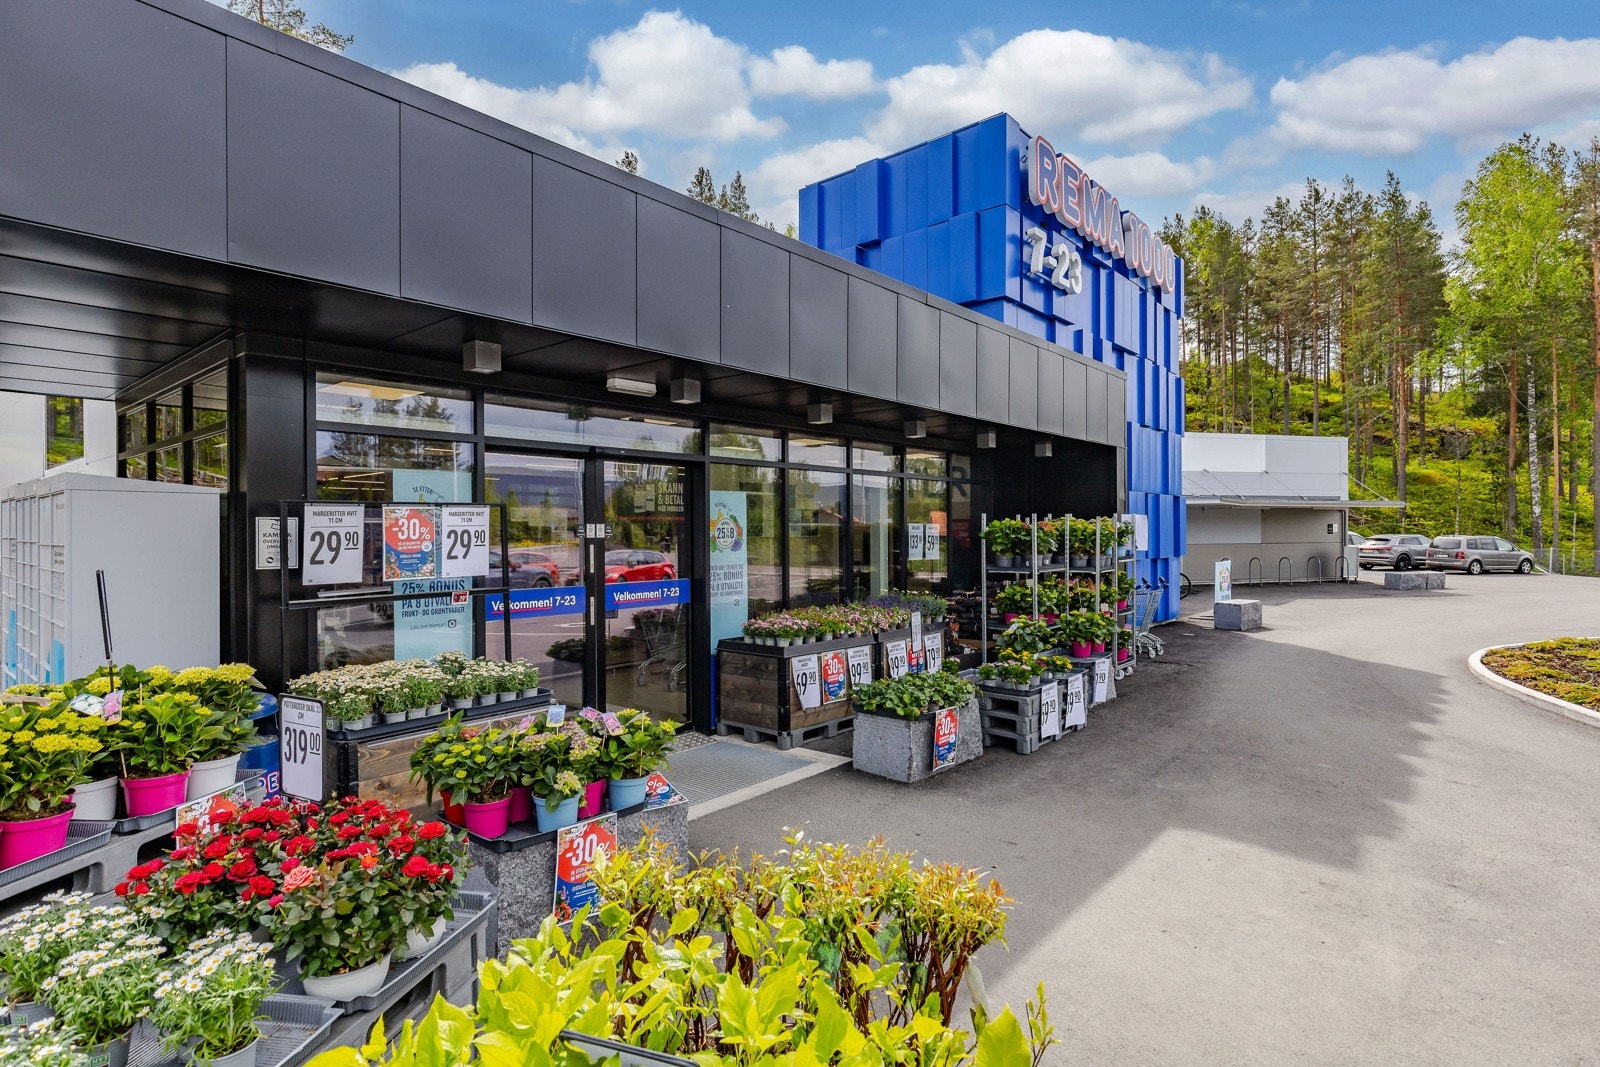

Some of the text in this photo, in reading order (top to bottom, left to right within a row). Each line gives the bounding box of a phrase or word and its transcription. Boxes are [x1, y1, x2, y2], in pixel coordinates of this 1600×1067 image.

[1029, 136, 1176, 294] REMA 1000
[1025, 227, 1083, 295] 7-23
[658, 482, 684, 494] SKANN
[665, 494, 684, 505] BETAL
[392, 518, 431, 540] -30%
[309, 531, 342, 565] 29
[344, 531, 359, 547] 90
[446, 529, 486, 560] 29 90
[927, 535, 935, 551] 59
[723, 570, 744, 581] BONUS
[429, 579, 465, 593] BONUS
[613, 587, 680, 602] Velkommen! 7-23
[720, 581, 744, 591] UTVALGTE
[491, 595, 576, 612] Vekommen! 7-23
[825, 658, 844, 675] -30%
[808, 671, 817, 683] 90
[937, 716, 956, 736] -30%
[284, 726, 321, 765] 319 00
